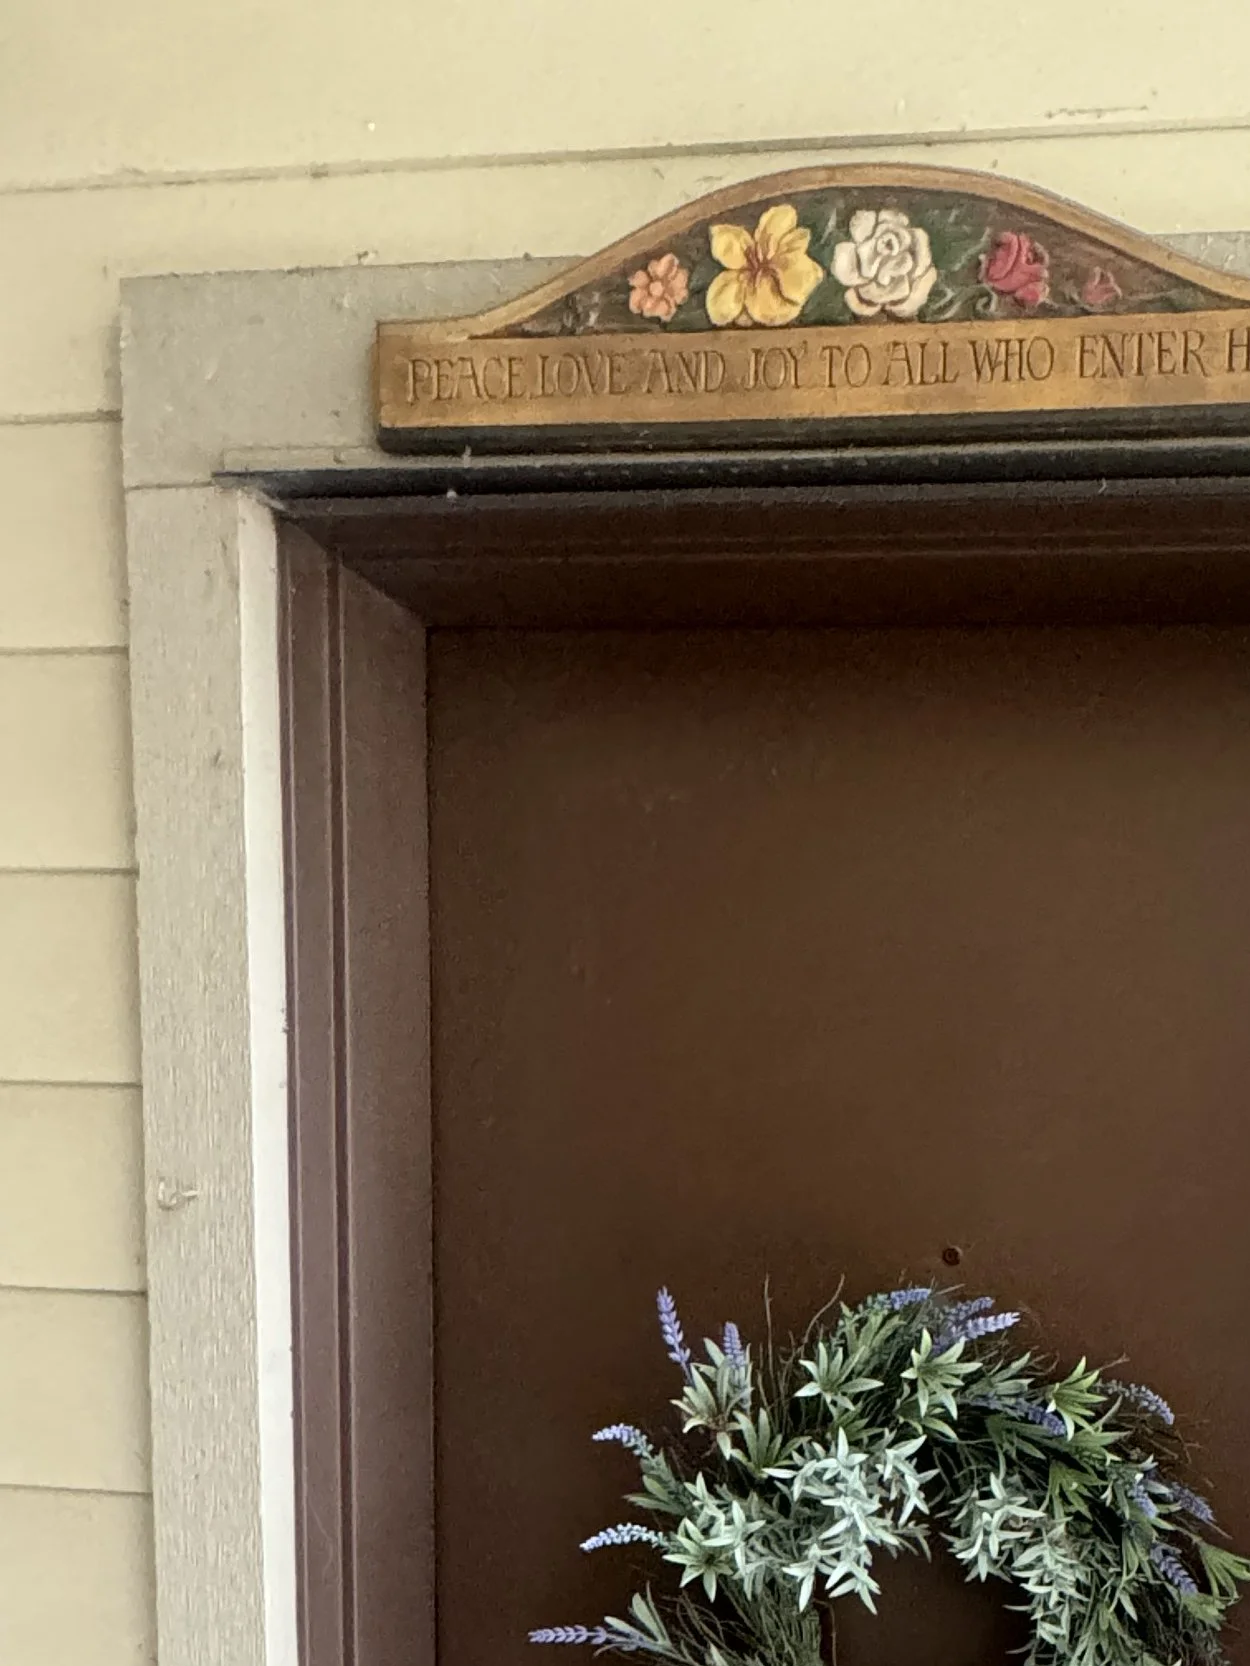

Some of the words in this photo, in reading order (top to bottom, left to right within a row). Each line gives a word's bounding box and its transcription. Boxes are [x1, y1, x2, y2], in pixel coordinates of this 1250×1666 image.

[535, 349, 632, 397] LOVE
[641, 348, 727, 394] AND
[744, 341, 807, 390] JOY
[818, 342, 872, 389] TO
[881, 339, 960, 387] ALL
[968, 335, 1056, 384] WHO
[1076, 329, 1209, 380] ENTER
